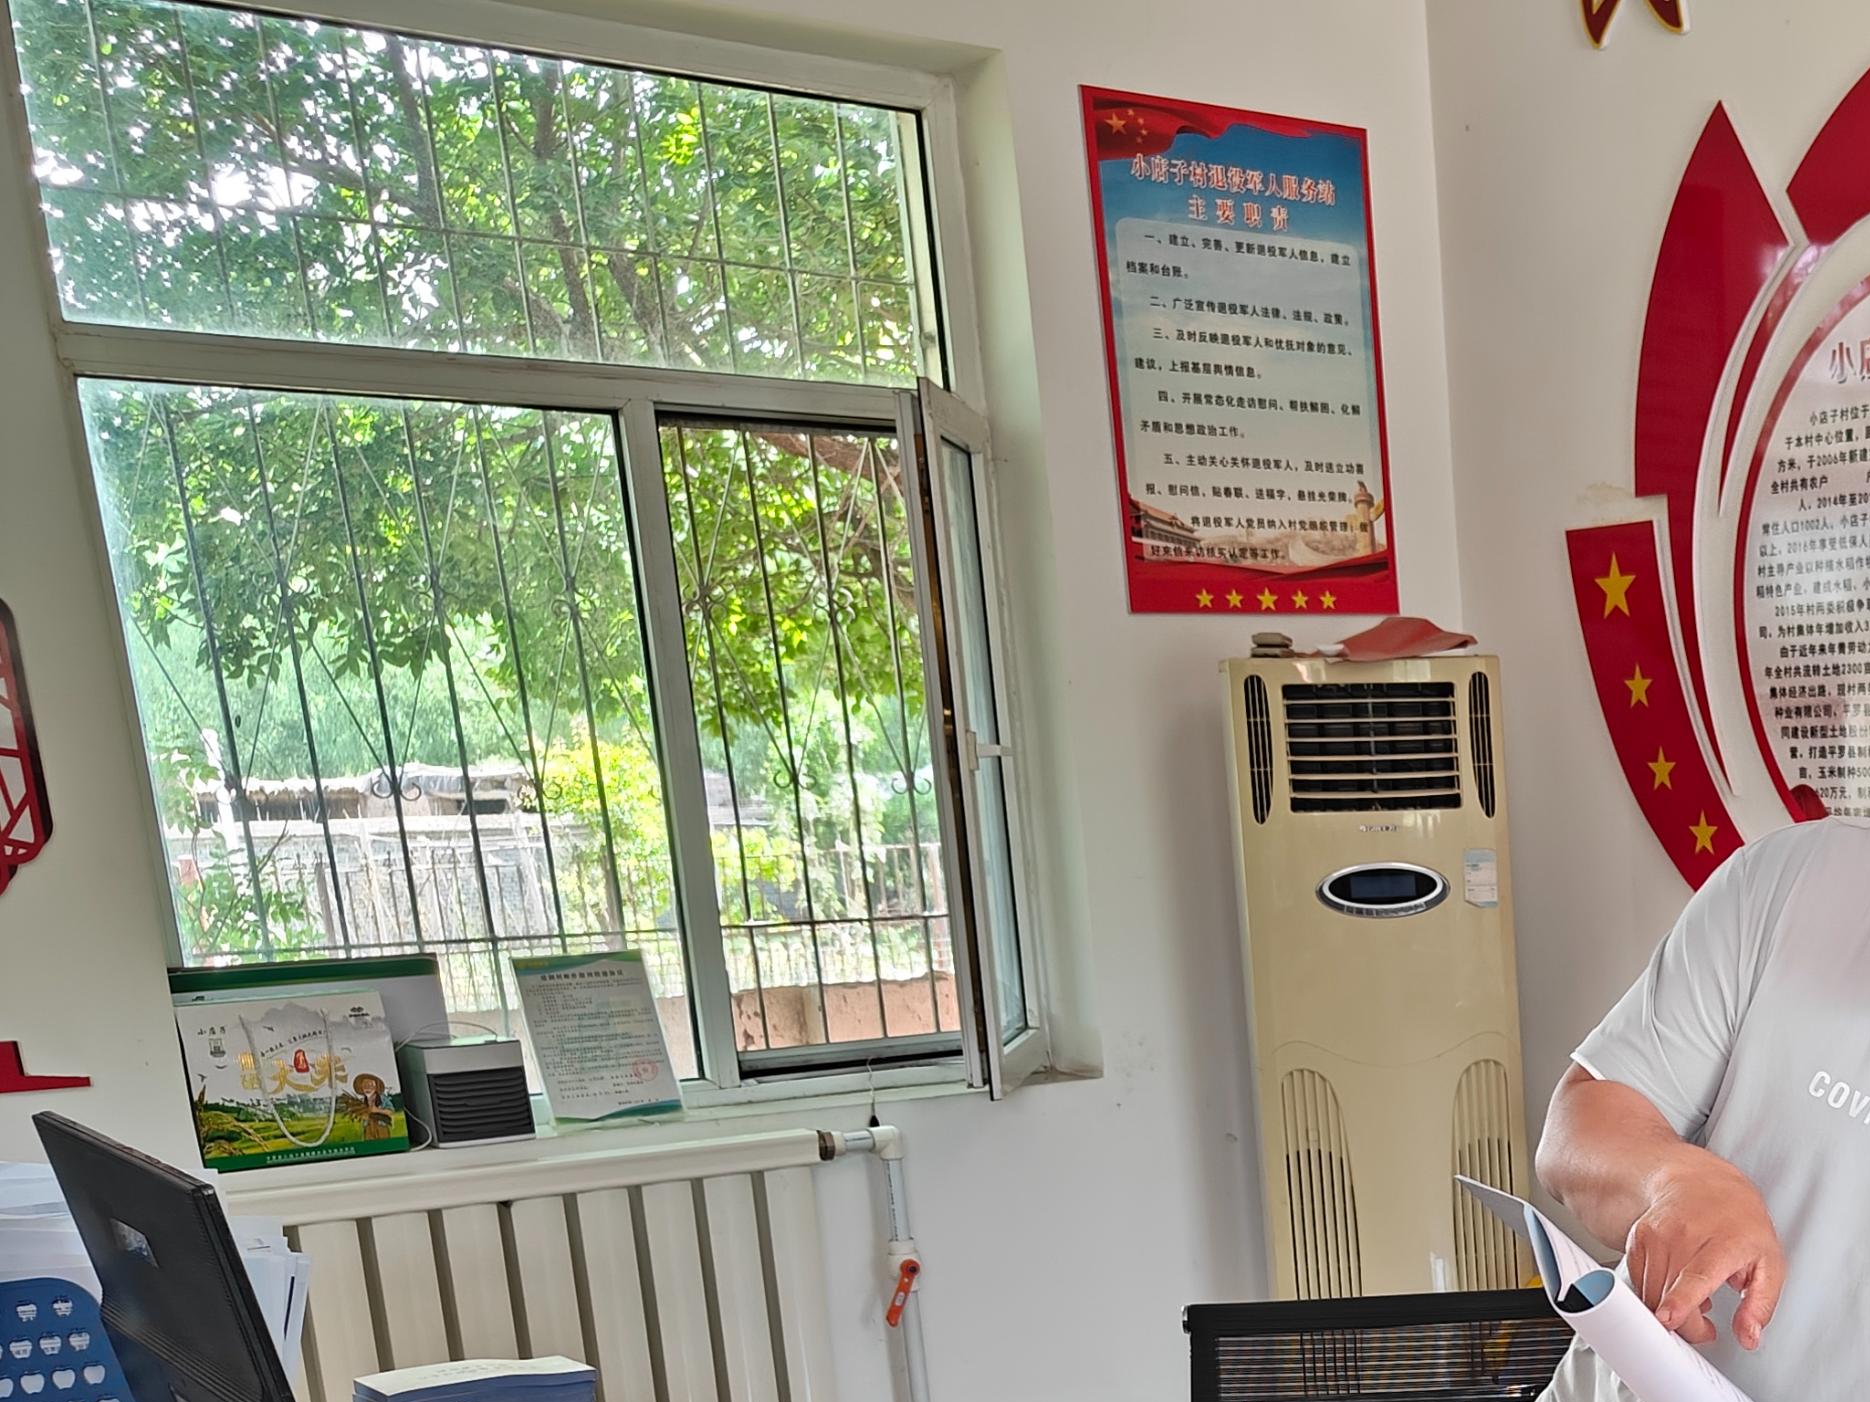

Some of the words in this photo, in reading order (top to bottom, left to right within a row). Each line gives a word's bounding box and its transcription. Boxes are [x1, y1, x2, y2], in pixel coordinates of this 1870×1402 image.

[1131, 153, 1336, 206] 小店子村退役军人服务站
[1188, 195, 1289, 231] 主要职责
